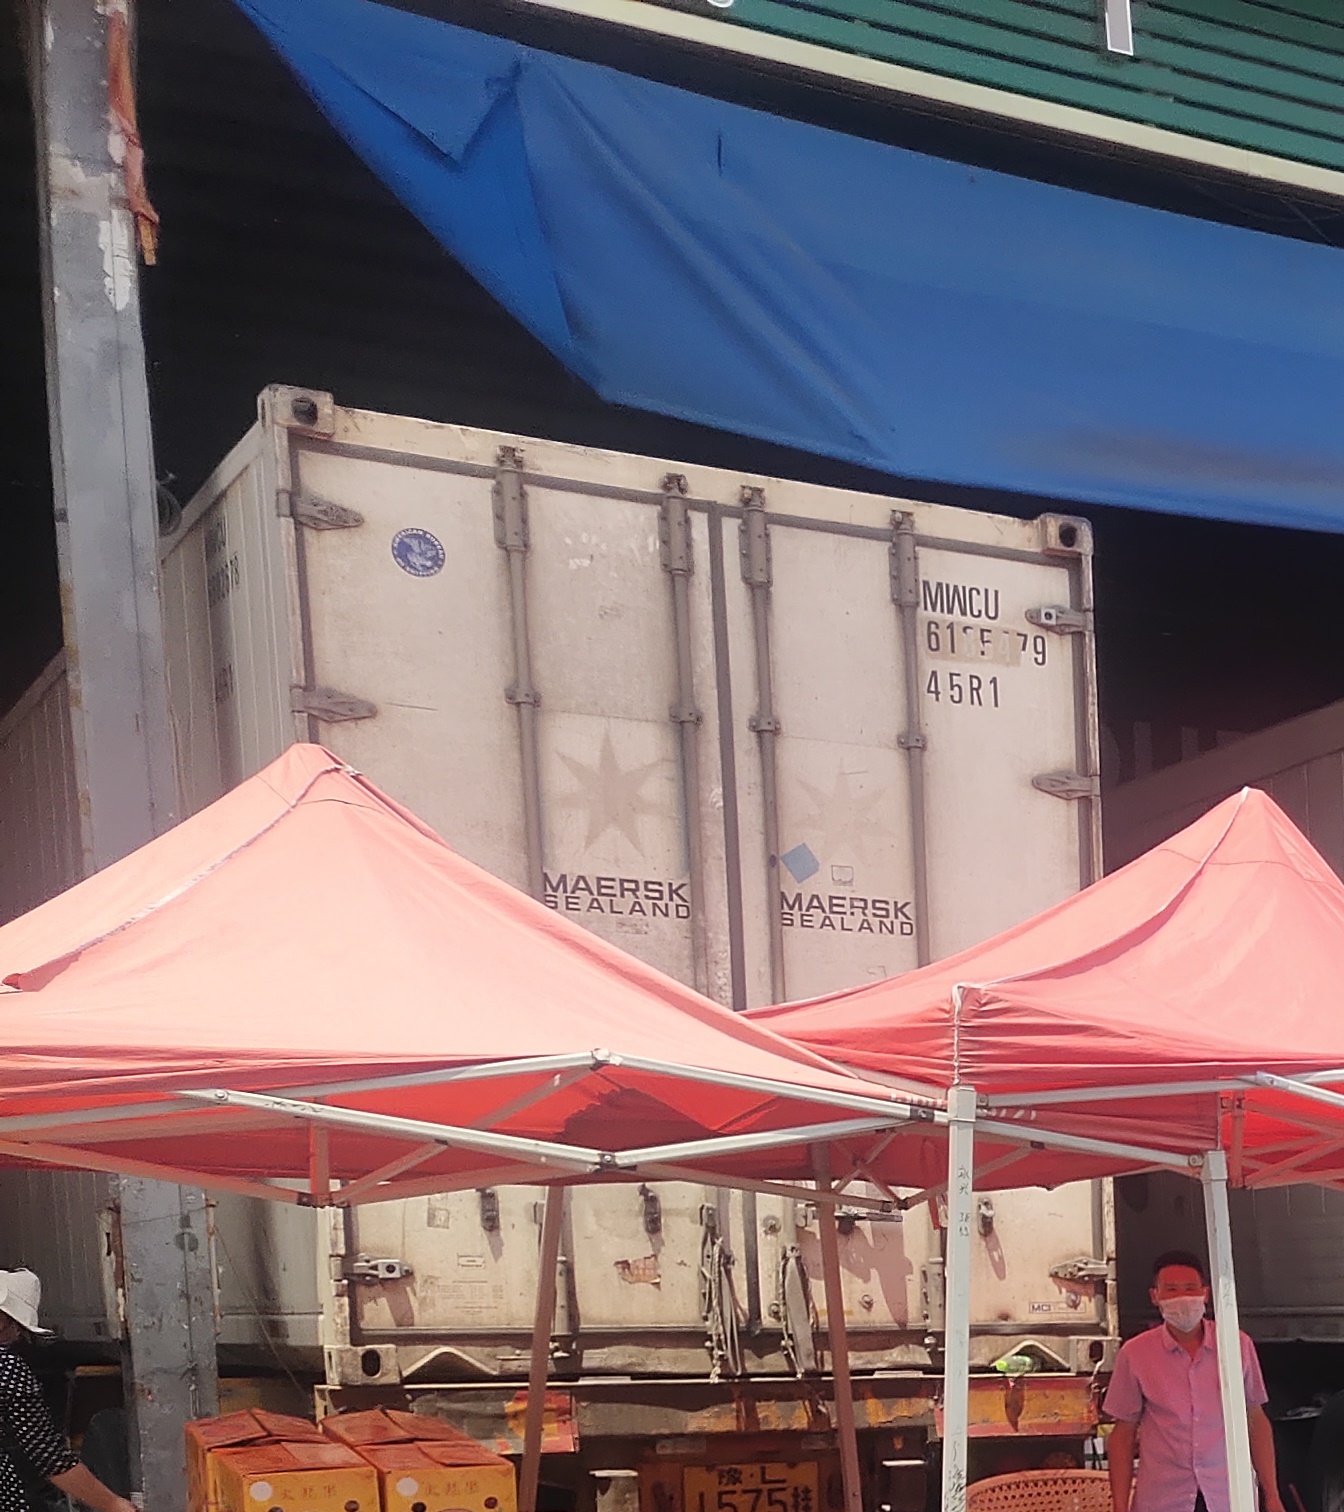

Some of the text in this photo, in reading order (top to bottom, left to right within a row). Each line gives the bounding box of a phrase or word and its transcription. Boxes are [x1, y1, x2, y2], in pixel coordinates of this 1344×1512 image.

[922, 580, 1000, 620] MWCU
[926, 669, 1000, 709] 45R1
[543, 872, 689, 903] MAERSK
[544, 894, 691, 919] SEALAND
[780, 892, 913, 920] MAERSK
[781, 912, 914, 936] SEALAND
